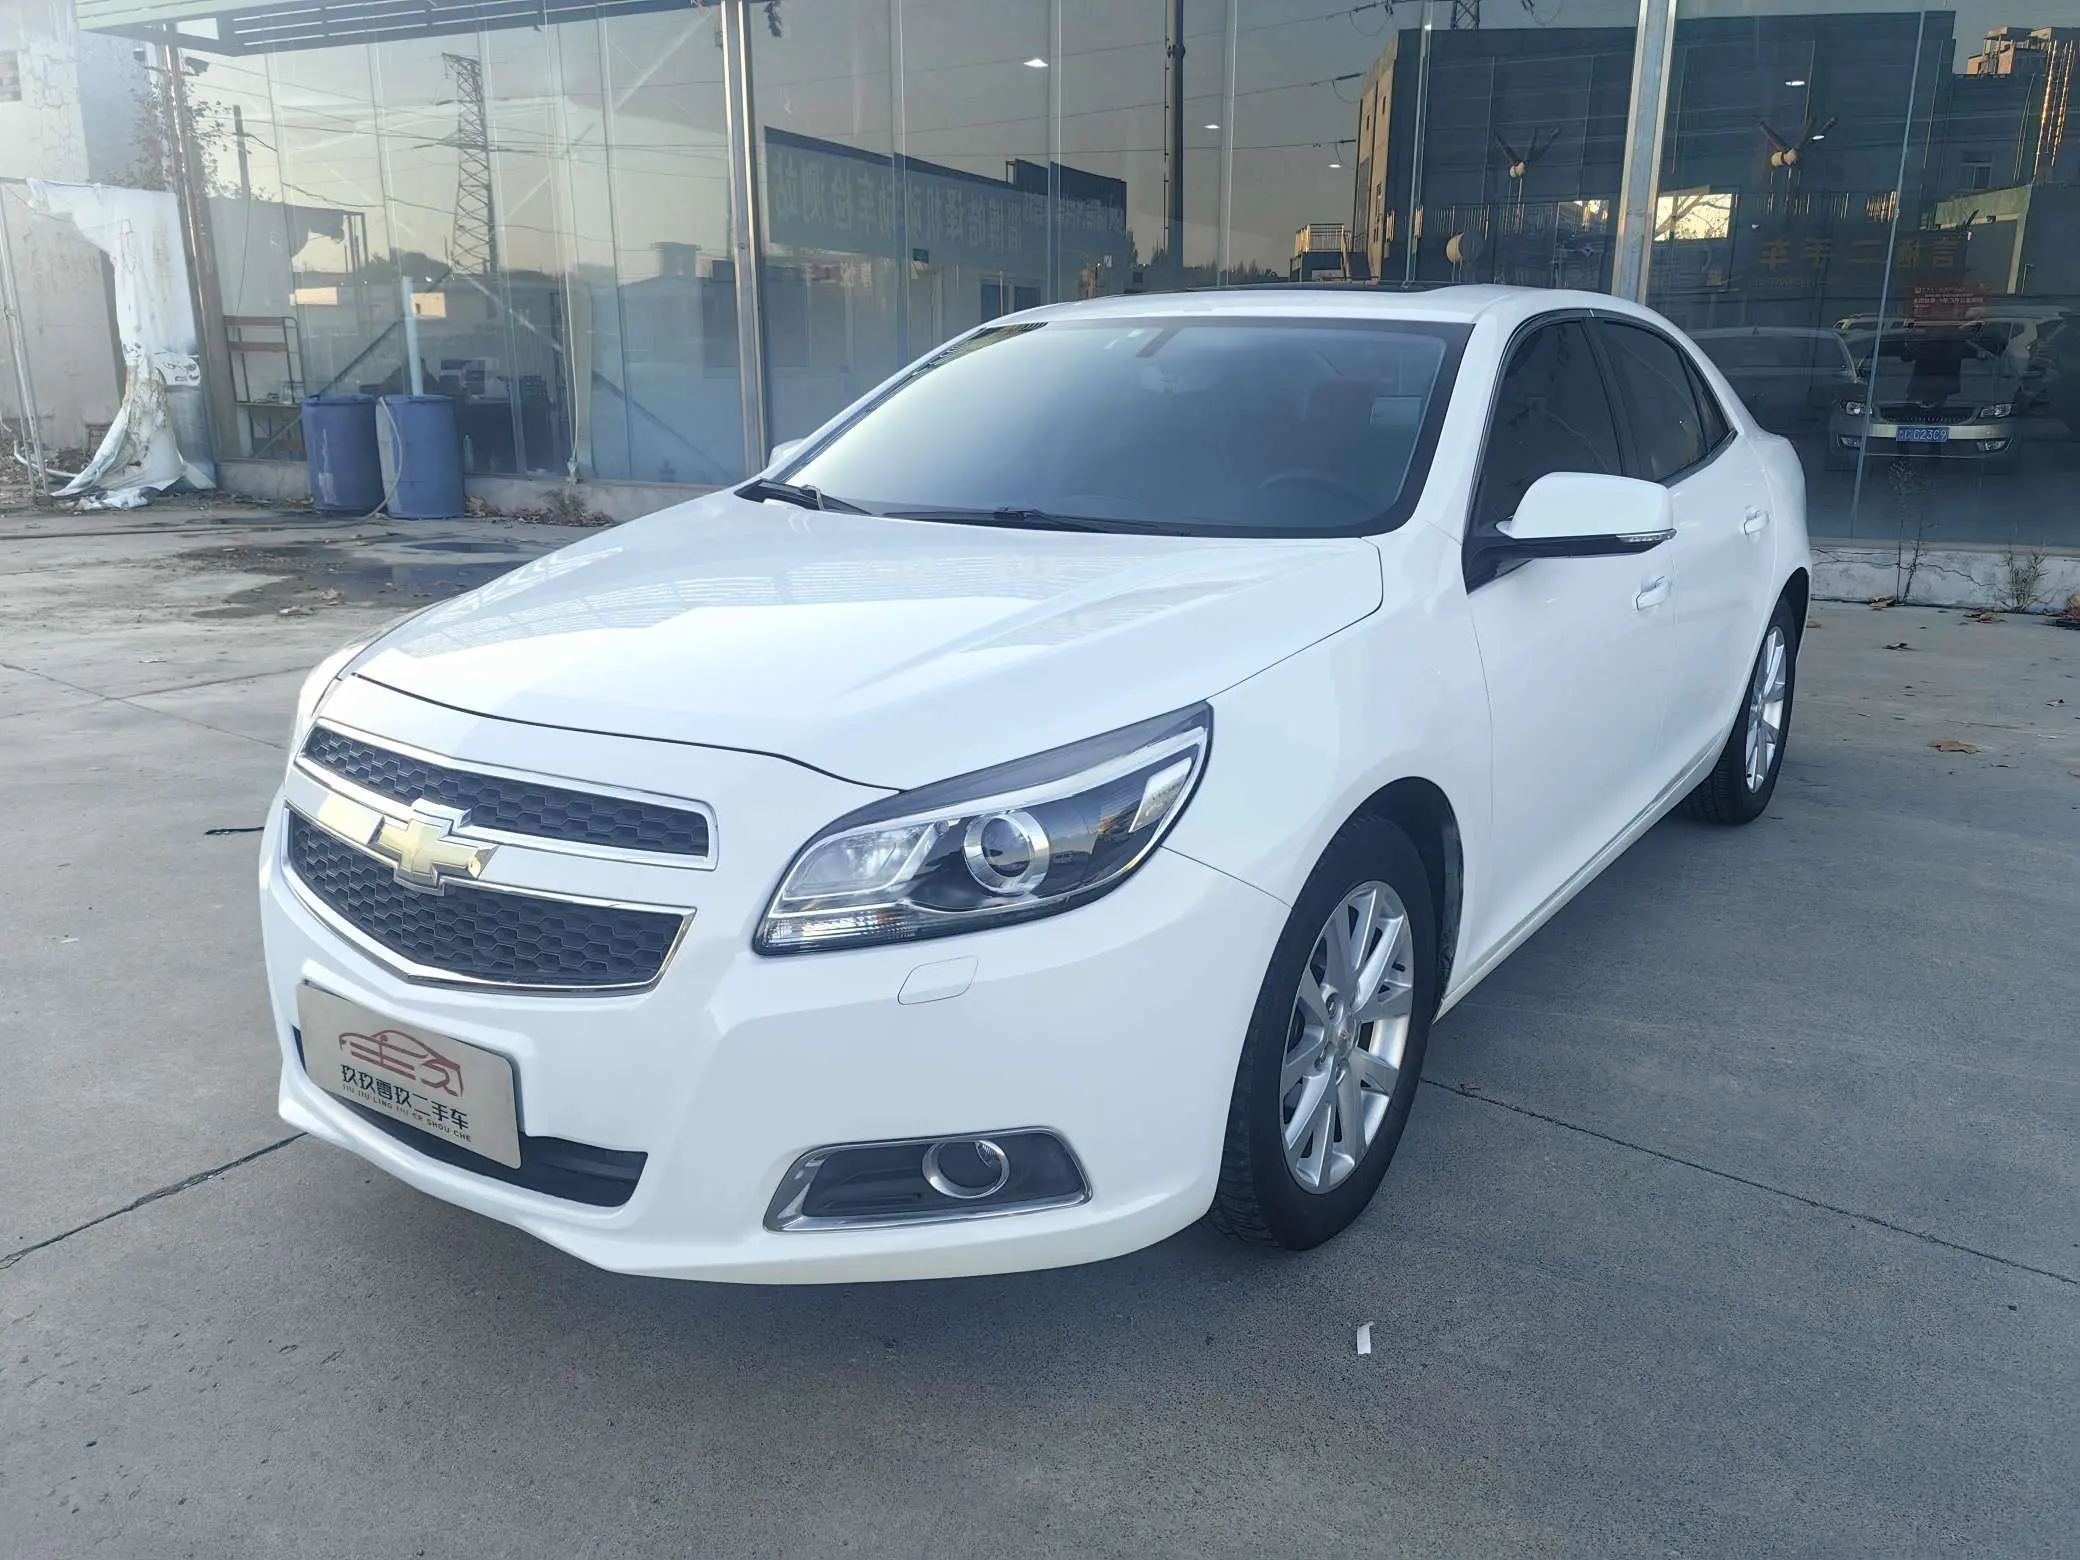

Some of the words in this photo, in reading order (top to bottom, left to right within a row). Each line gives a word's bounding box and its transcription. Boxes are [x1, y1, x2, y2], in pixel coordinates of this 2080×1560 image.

[373, 1096, 393, 1110] LING
[427, 1118, 450, 1134] SHOU
[453, 1128, 472, 1143] CHE
